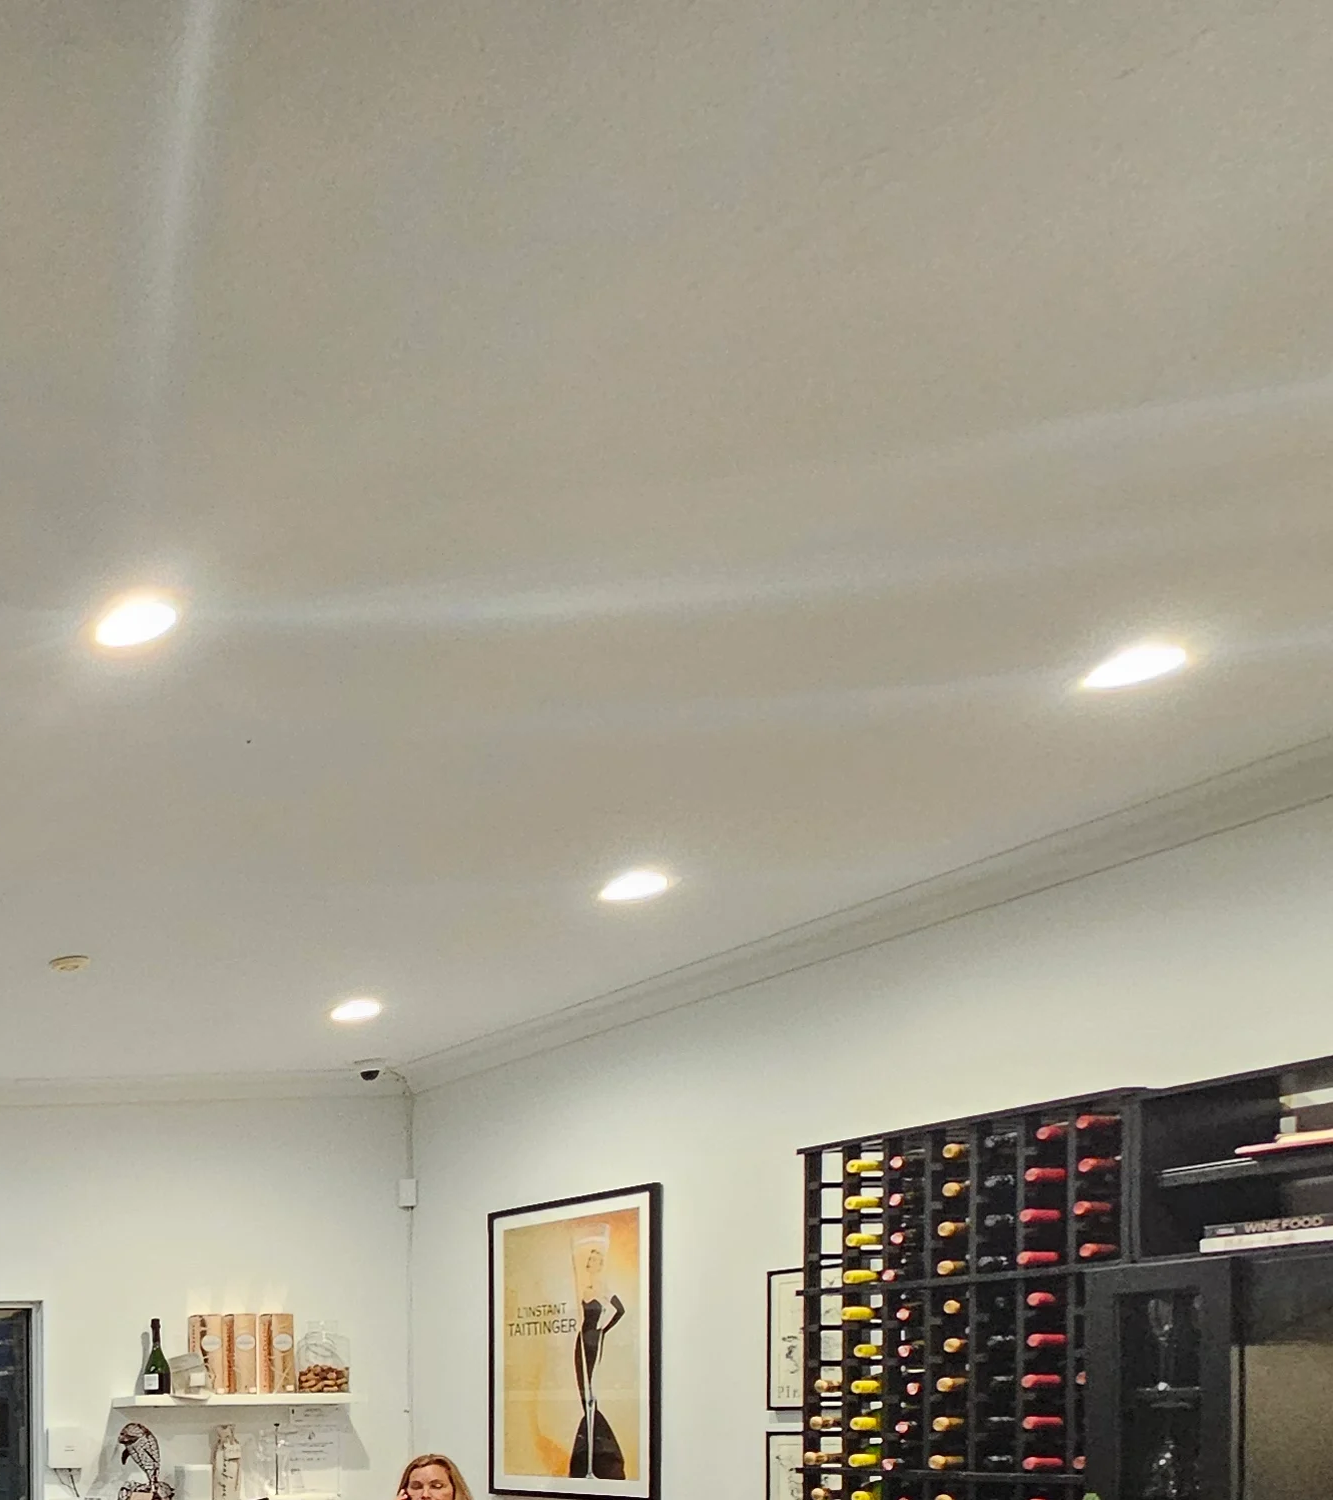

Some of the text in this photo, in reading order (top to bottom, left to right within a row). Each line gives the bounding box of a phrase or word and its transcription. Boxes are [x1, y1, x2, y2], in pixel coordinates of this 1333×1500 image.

[1244, 1214, 1324, 1233] WINE FOOD
[517, 1302, 567, 1319] L'INSTANT
[507, 1318, 578, 1337] TAITTINGER
